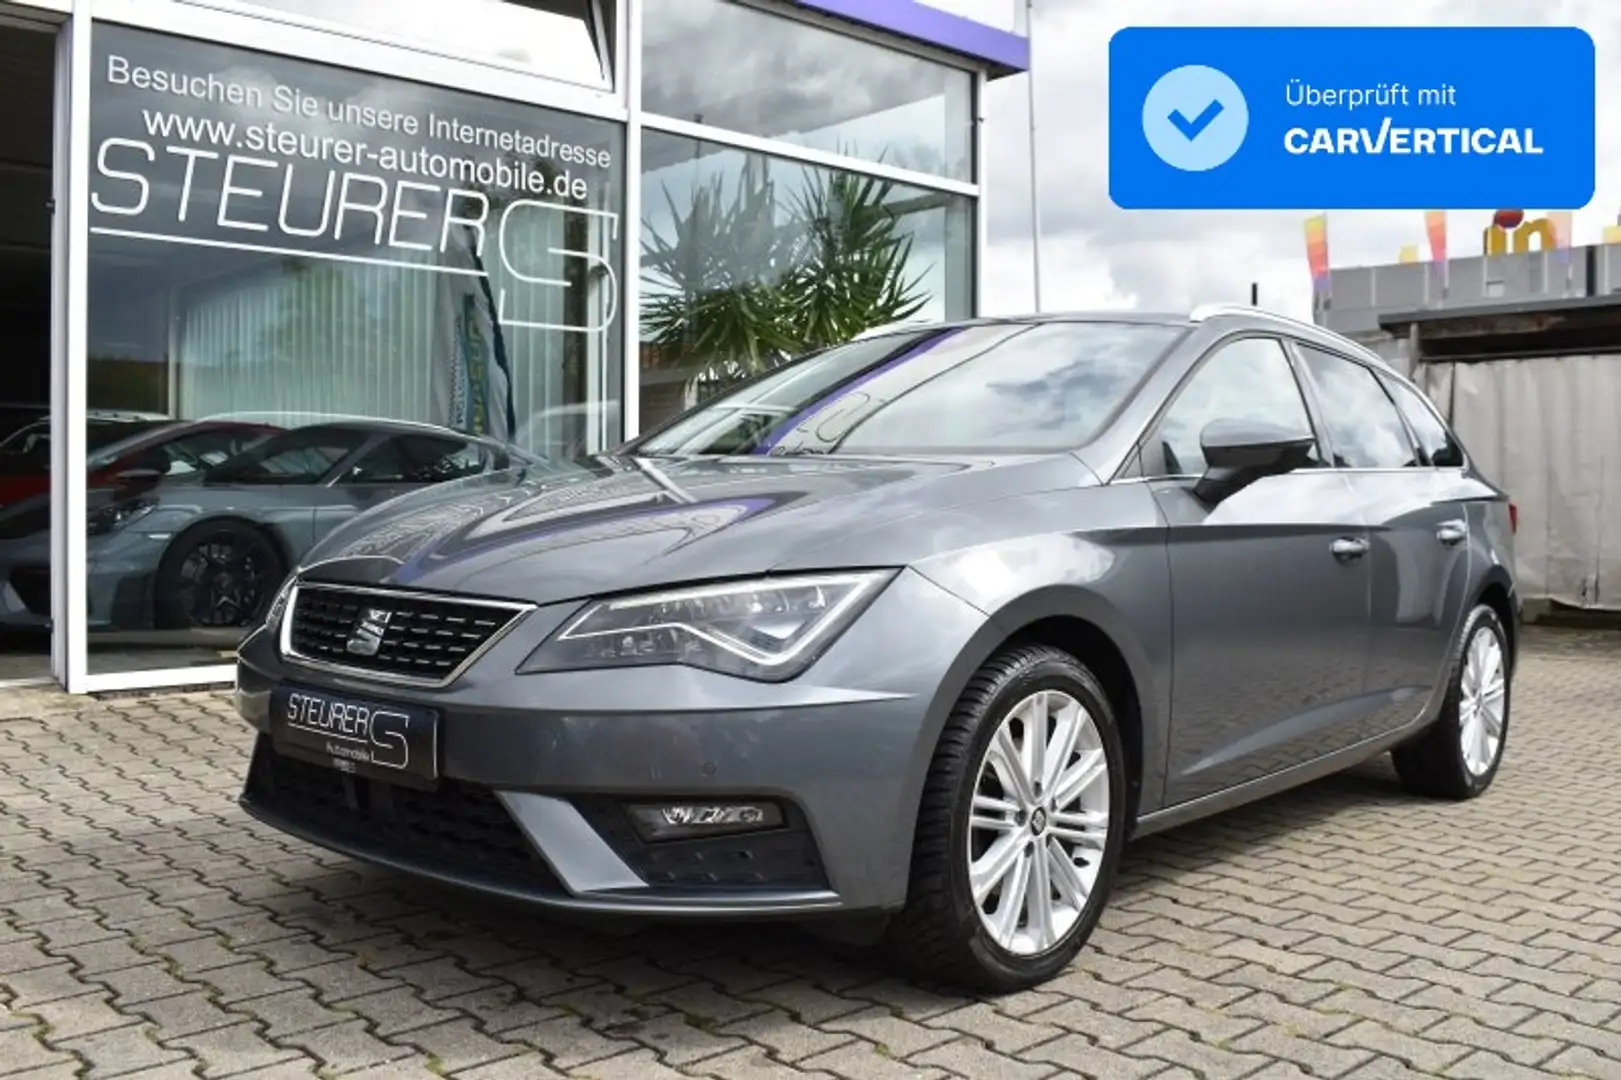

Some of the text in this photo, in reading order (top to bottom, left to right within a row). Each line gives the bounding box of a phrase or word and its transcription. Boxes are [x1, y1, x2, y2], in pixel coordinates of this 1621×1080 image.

[108, 56, 611, 169] Besuchen Sie unsere Internetadresse
[142, 108, 589, 201] www.steurer-automobile.de
[90, 137, 490, 256] STEURER
[287, 692, 370, 736] STEURER
